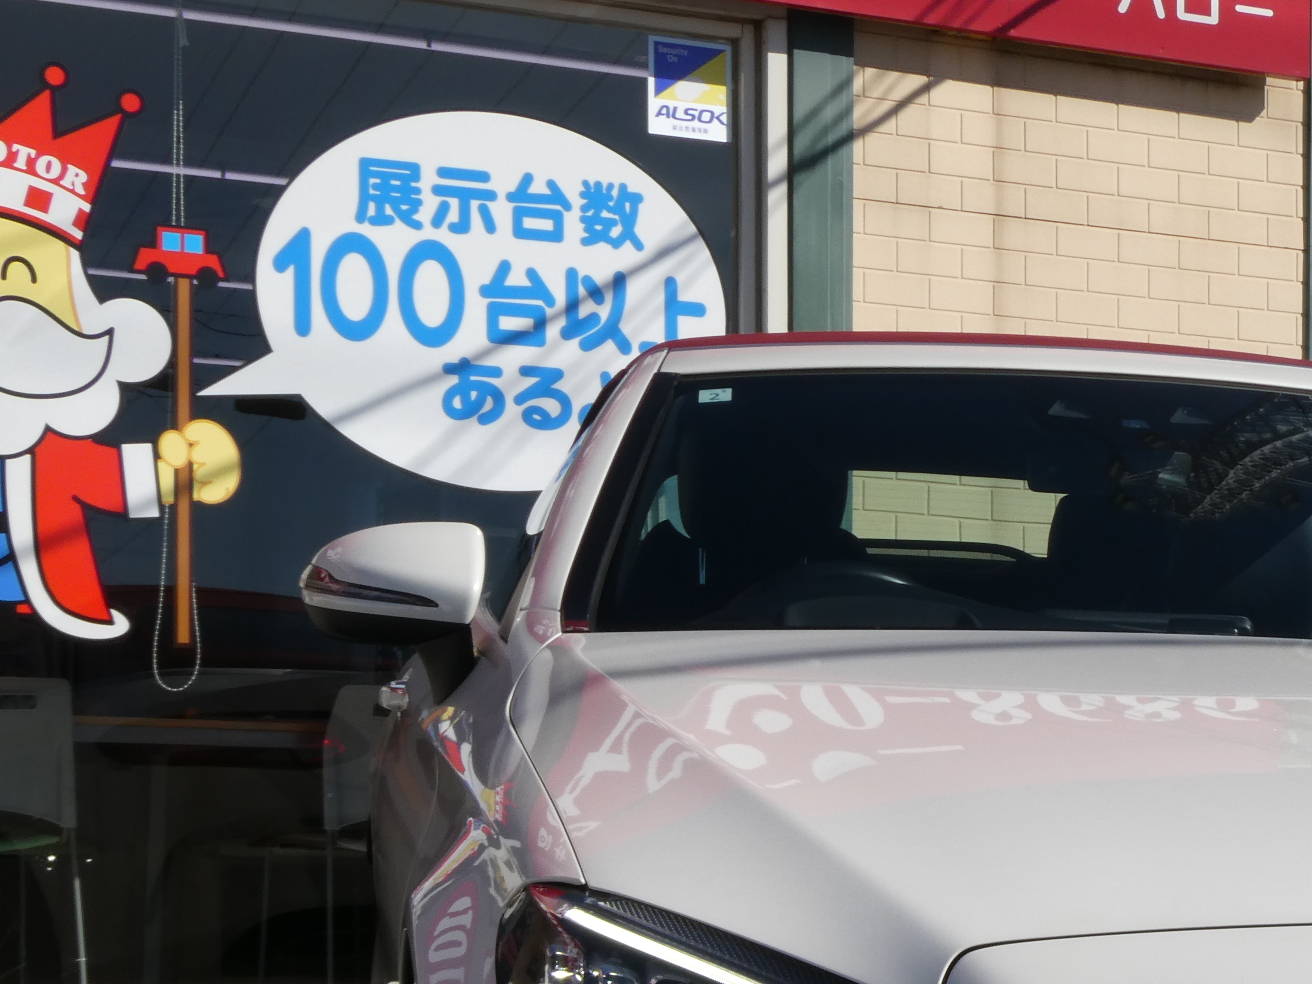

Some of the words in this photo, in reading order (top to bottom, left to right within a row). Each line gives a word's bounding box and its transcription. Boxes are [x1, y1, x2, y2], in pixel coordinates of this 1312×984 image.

[0, 140, 88, 195] TOR
[355, 156, 645, 252] 展示台数
